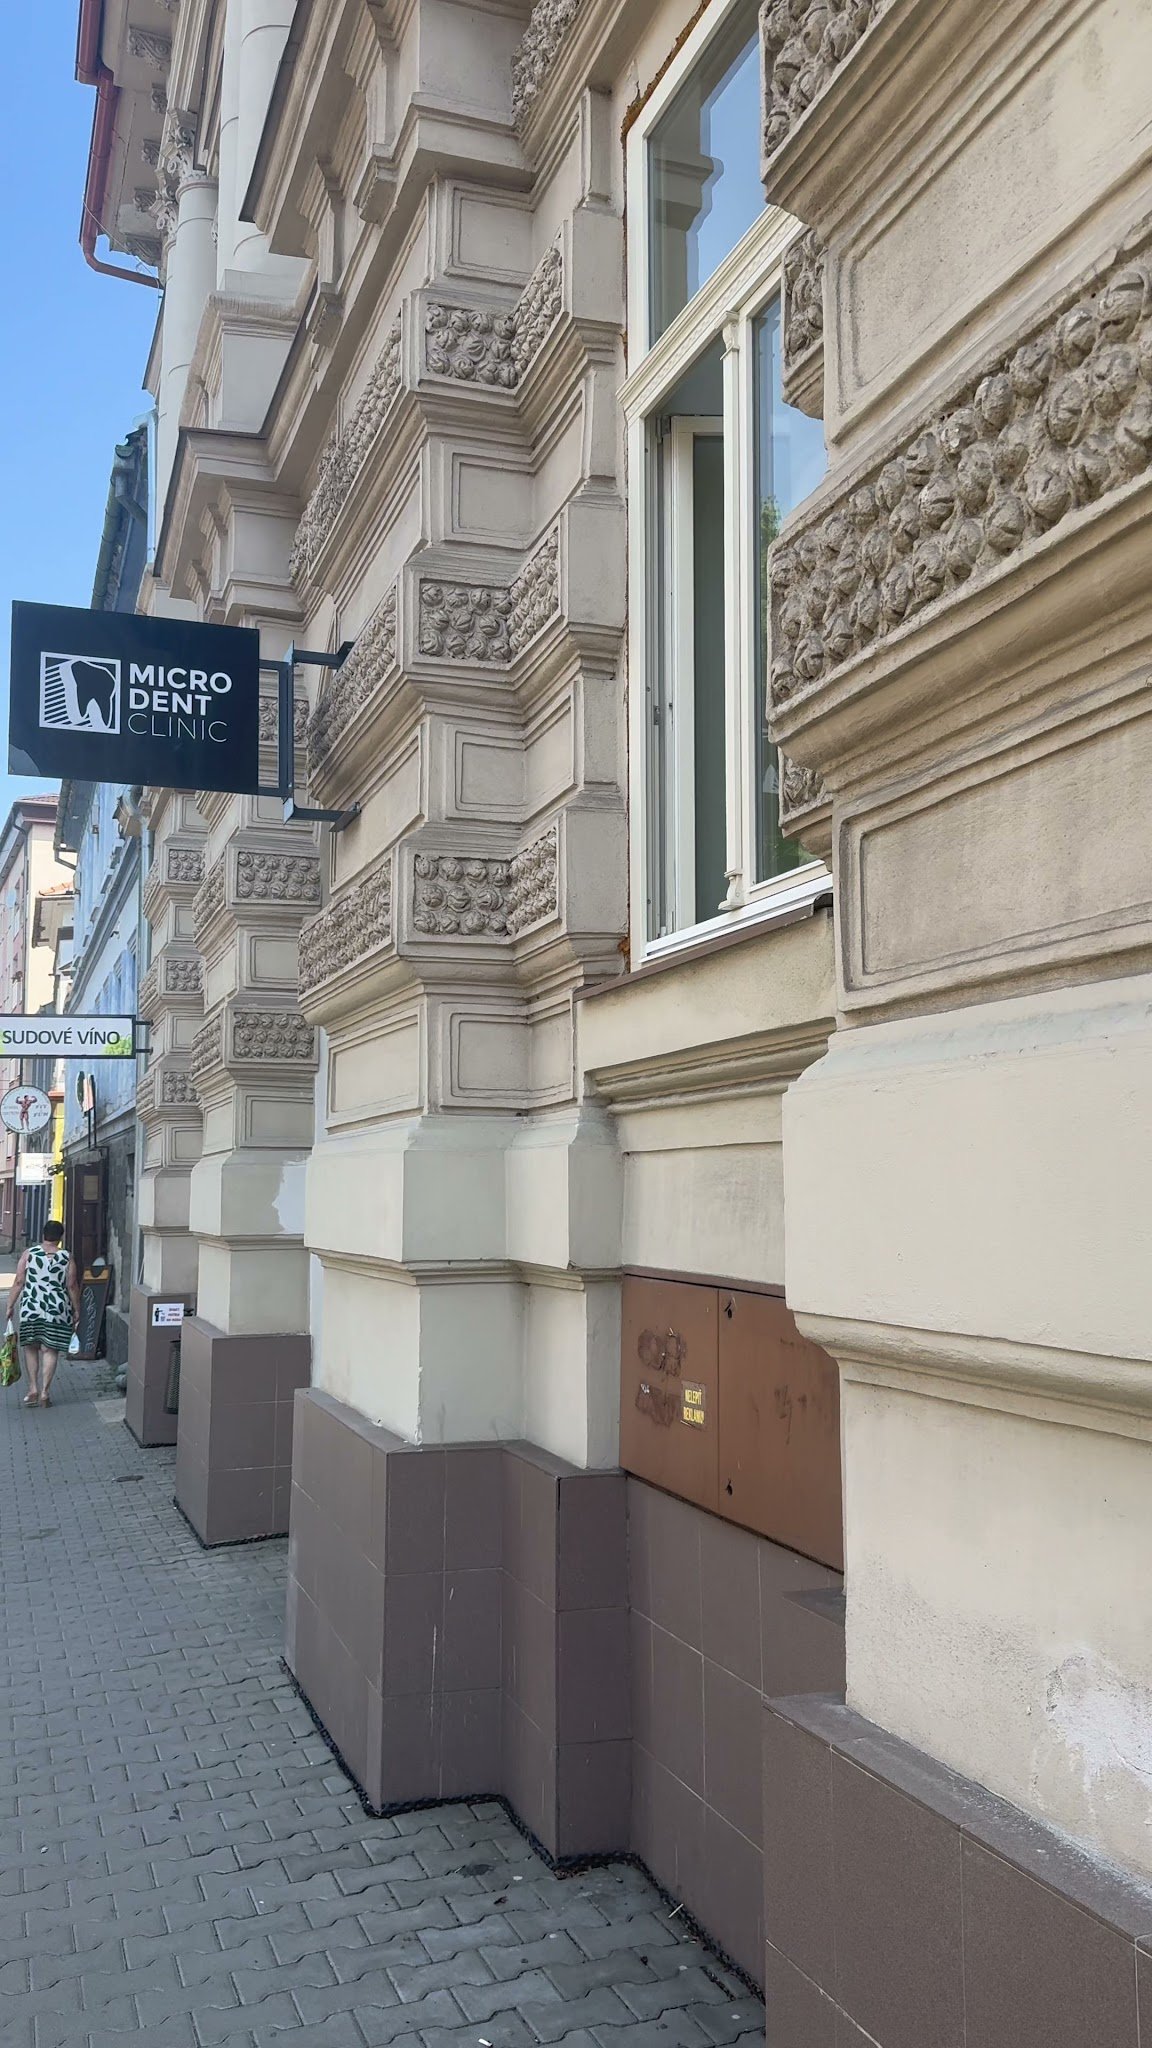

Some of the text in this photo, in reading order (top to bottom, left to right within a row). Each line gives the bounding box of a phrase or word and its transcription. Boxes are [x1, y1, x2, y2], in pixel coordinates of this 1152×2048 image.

[129, 663, 232, 694] MICRO
[129, 688, 212, 716] DENT
[127, 713, 228, 743] CLINIC
[2, 1027, 121, 1045] SUDOVÉ VÍNO
